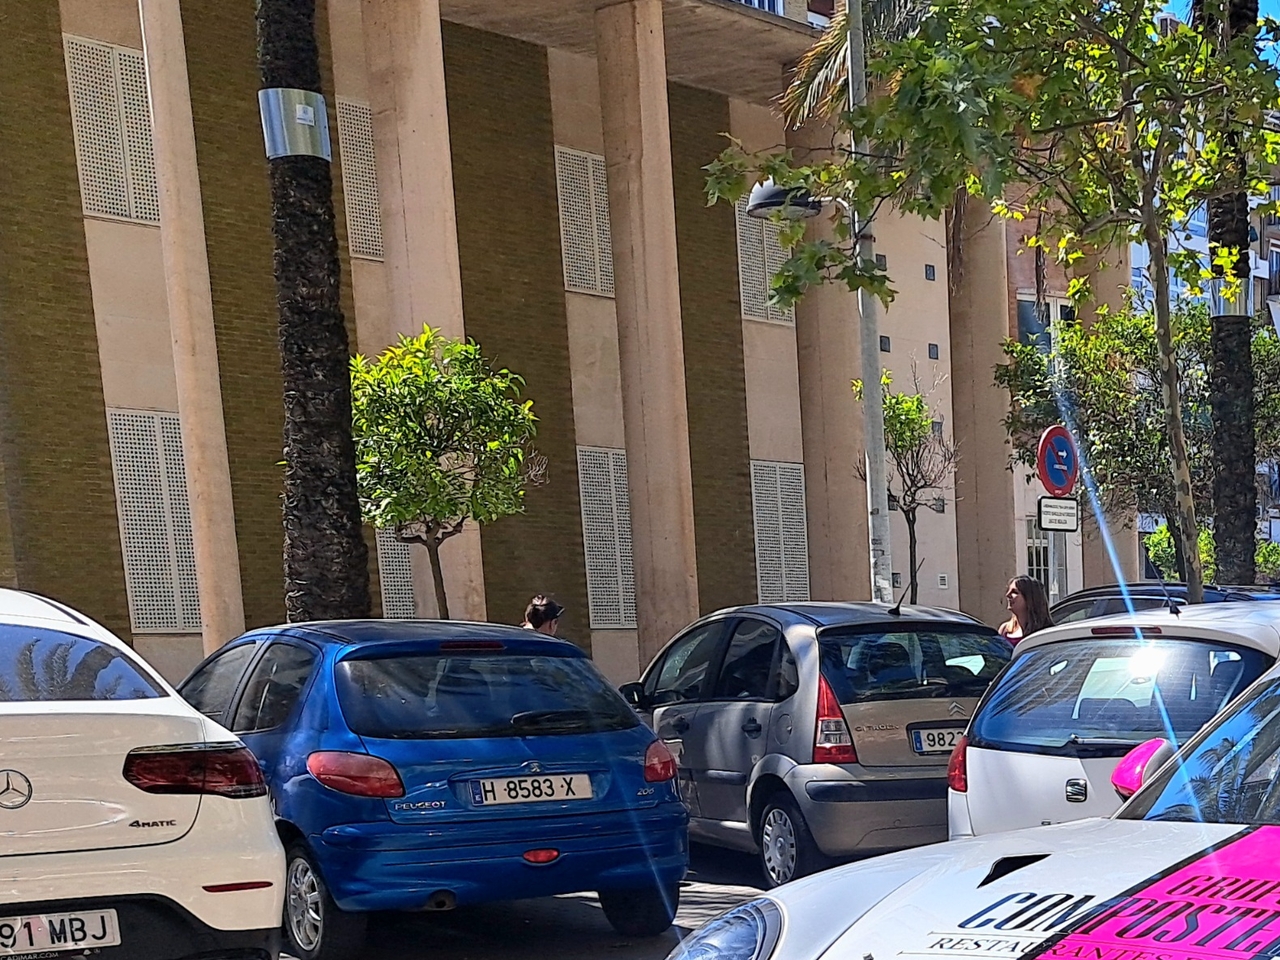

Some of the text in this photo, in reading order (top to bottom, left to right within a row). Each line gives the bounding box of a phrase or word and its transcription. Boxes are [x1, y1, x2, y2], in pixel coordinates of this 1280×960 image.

[926, 731, 963, 747] 982
[483, 777, 576, 801] H 8583 X
[637, 787, 655, 796] 206
[394, 801, 446, 810] PEUGEOT
[128, 820, 177, 828] 4MATIC
[48, 915, 108, 945] MBJ
